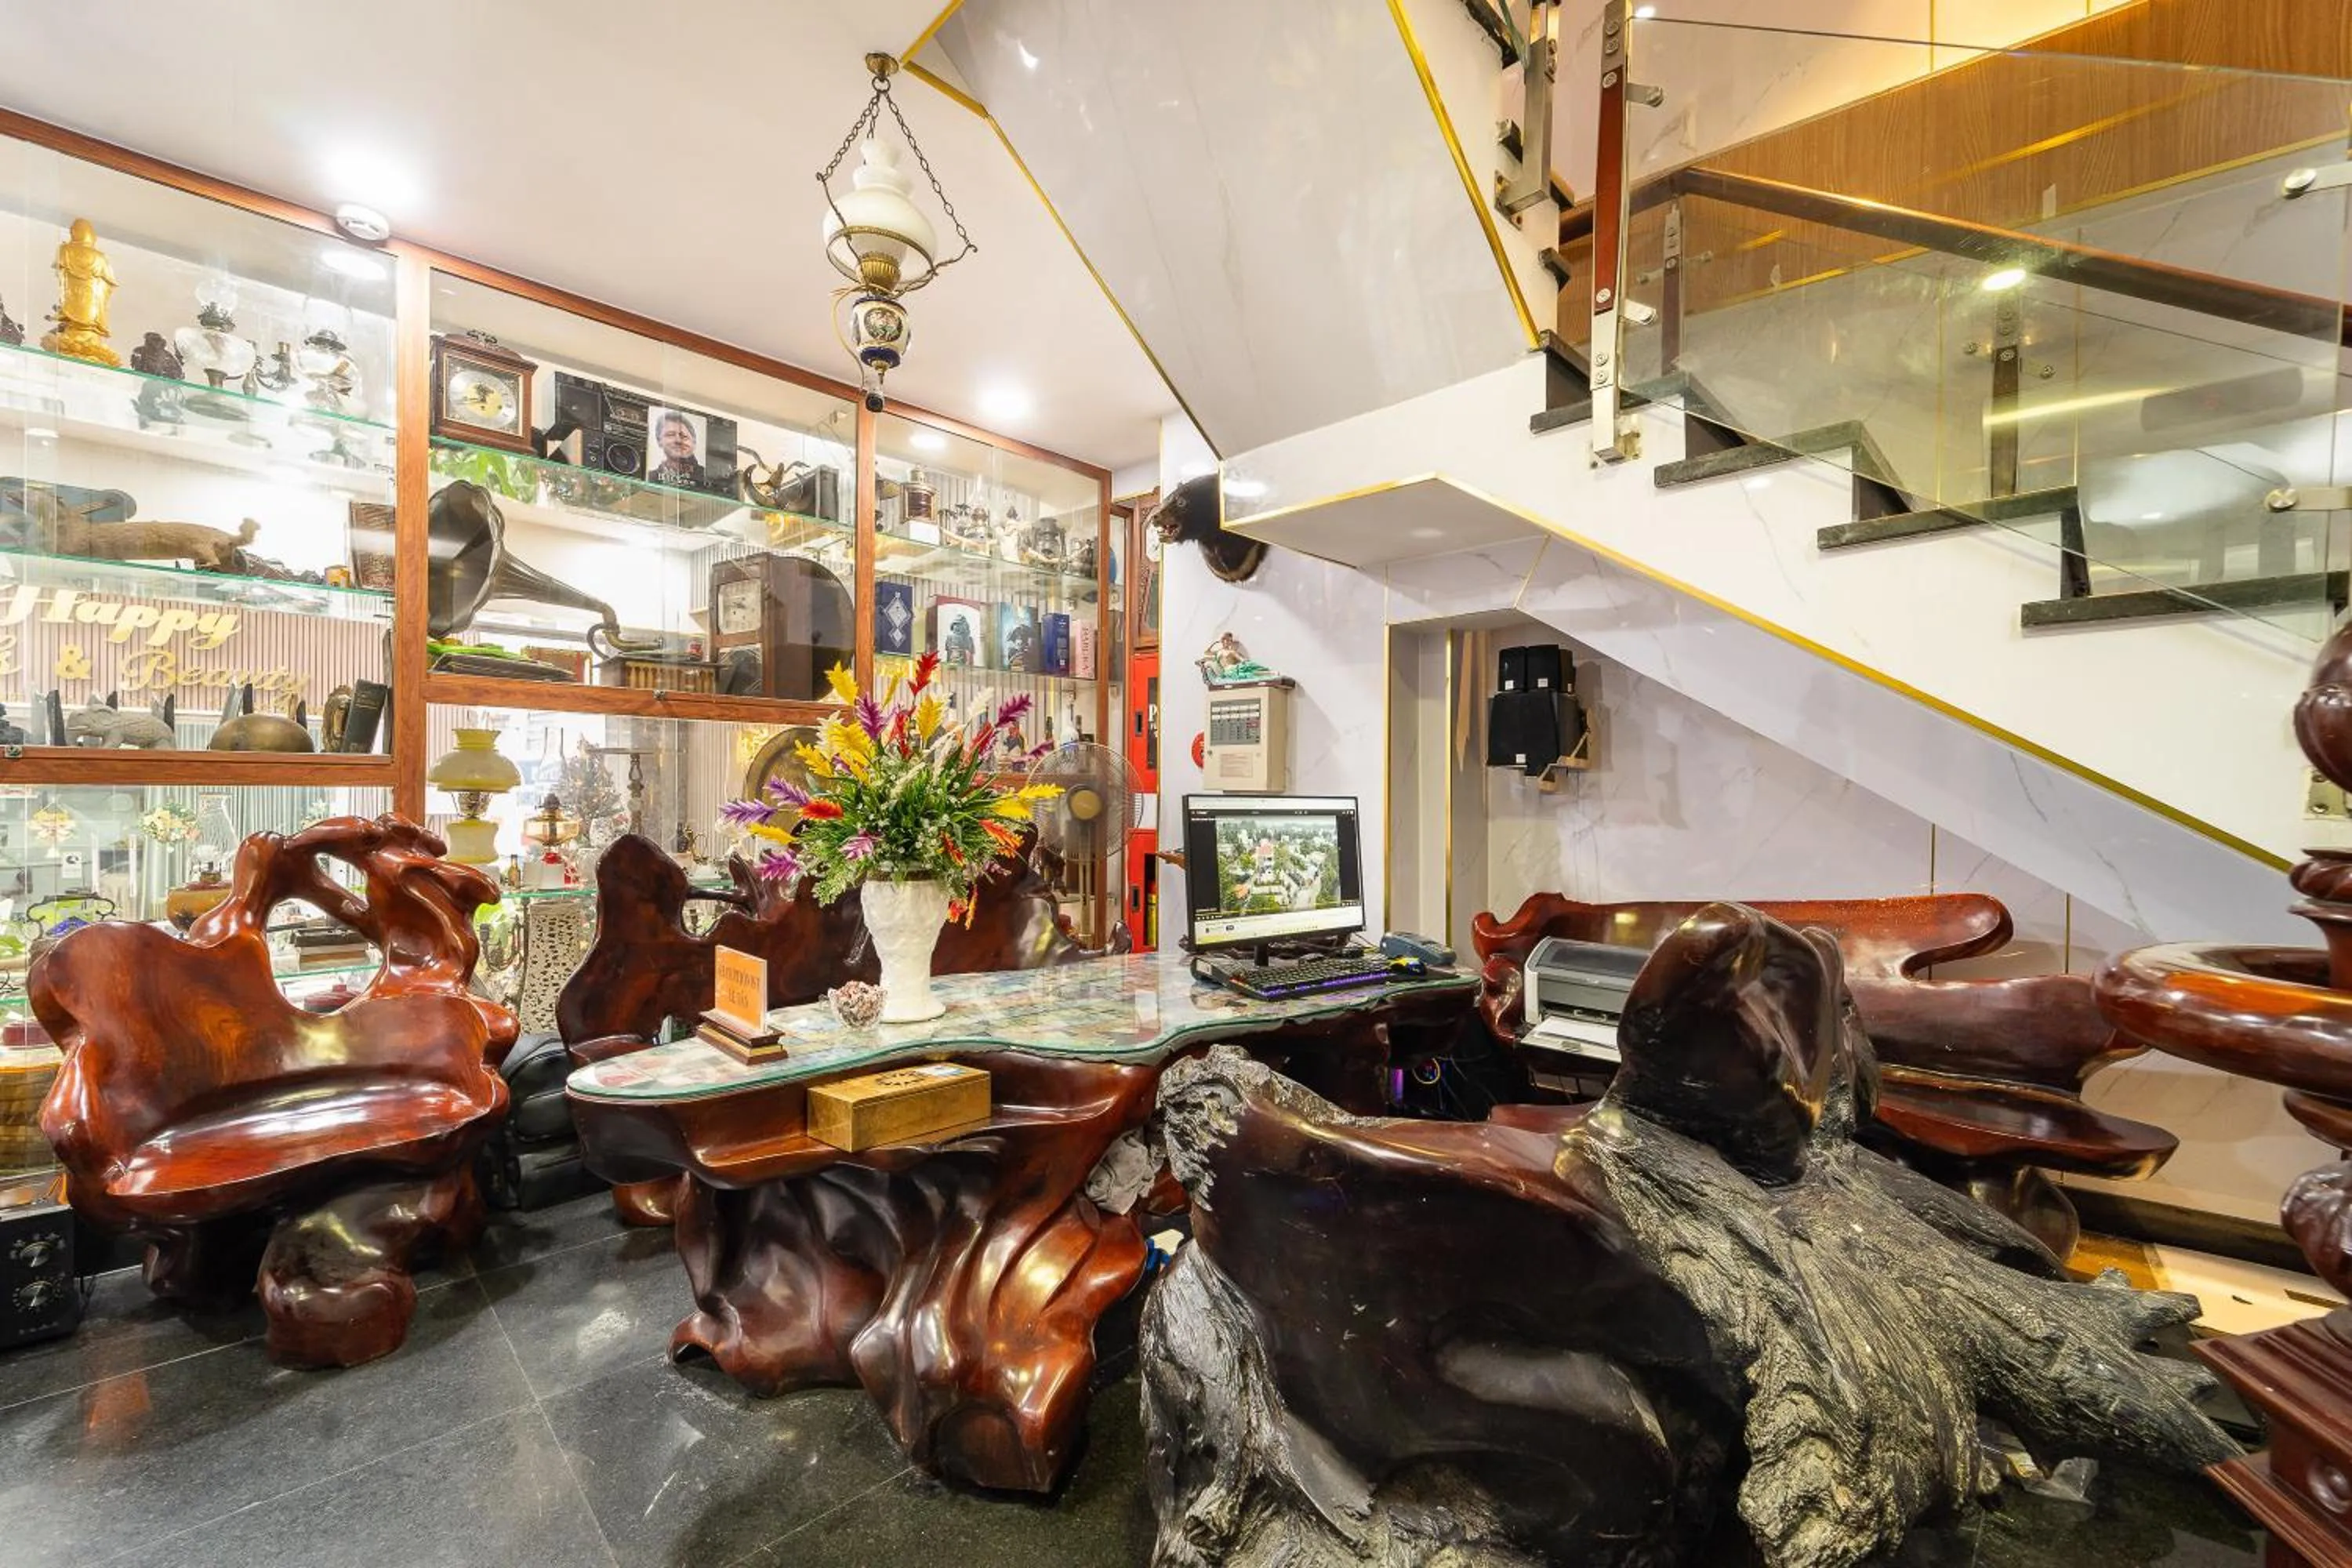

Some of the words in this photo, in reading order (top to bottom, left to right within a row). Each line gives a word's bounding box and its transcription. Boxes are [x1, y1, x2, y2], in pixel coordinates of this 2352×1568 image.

[0, 583, 242, 650] Happy
[55, 643, 93, 681] &
[119, 649, 310, 710] Beauty
